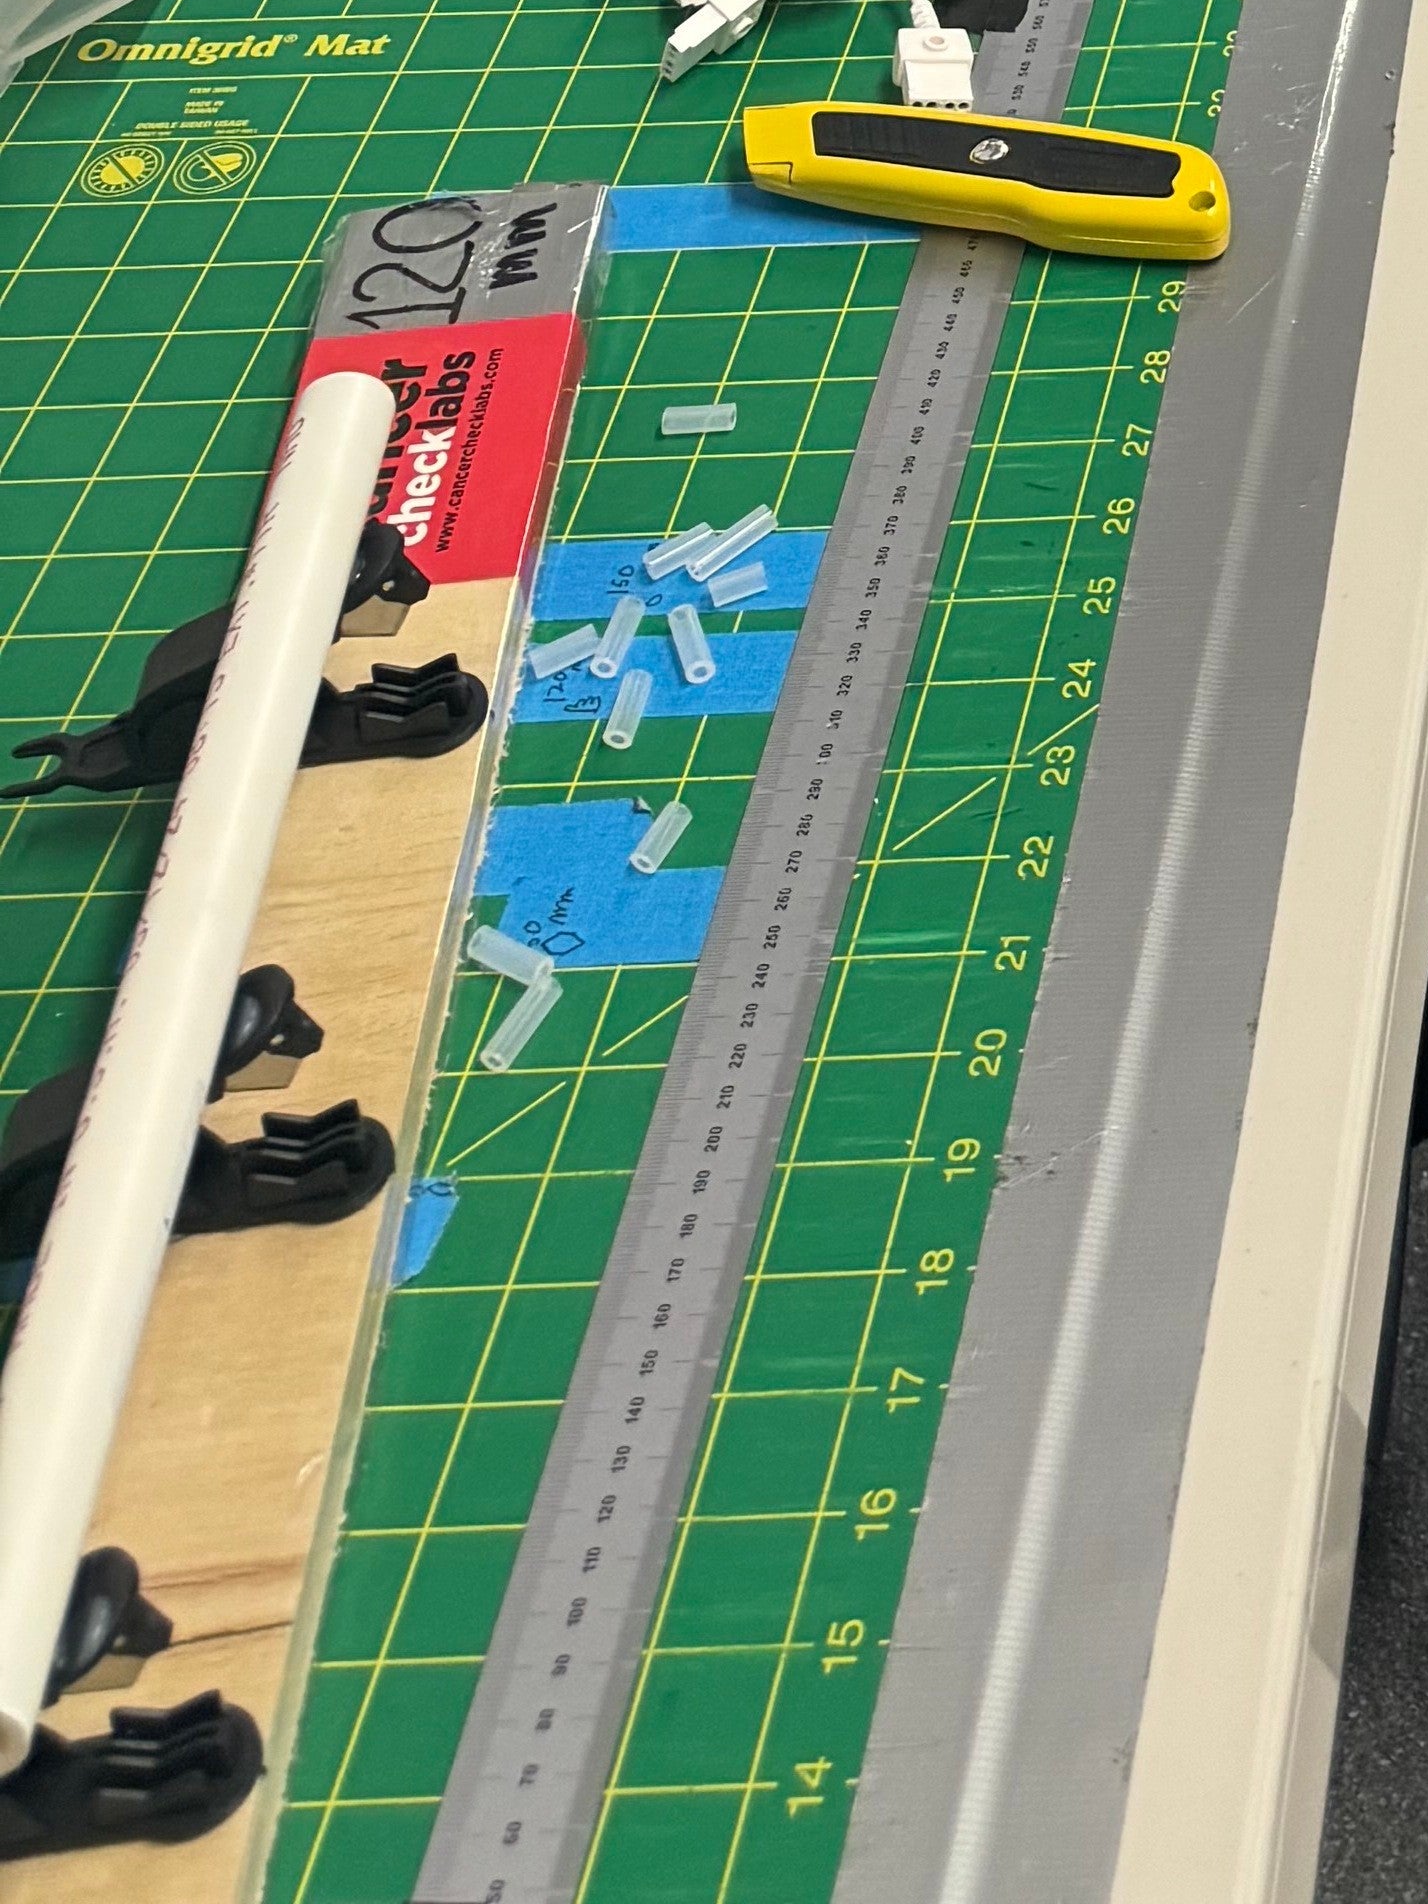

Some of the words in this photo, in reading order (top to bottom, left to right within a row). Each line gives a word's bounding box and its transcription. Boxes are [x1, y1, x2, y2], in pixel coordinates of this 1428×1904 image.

[304, 34, 391, 57] Mat
[489, 202, 558, 290] mm
[347, 196, 483, 330] 120
[1157, 280, 1187, 314] 29
[927, 369, 941, 388] 420
[1140, 349, 1171, 384] 28
[435, 347, 504, 553] www.cancerchecklabs.com
[1121, 423, 1154, 457] 27
[883, 515, 899, 536] 370
[1102, 497, 1135, 535] 26
[1083, 576, 1116, 614] 25
[856, 609, 872, 632] 340
[846, 642, 862, 664] 330
[837, 674, 853, 697] 320
[1061, 658, 1097, 699] 24
[1040, 745, 1076, 786] 23
[806, 778, 824, 801] 290
[796, 813, 814, 837] 280
[785, 850, 803, 874] 270
[1017, 835, 1055, 880] 22
[774, 887, 793, 912] 260
[763, 924, 781, 950] 250
[994, 935, 1031, 972] 21
[752, 962, 770, 989] 240
[740, 1003, 759, 1029] 230
[728, 1043, 747, 1070] 220
[968, 1028, 1008, 1077] 20
[716, 1085, 735, 1110] 210
[704, 1126, 723, 1153] 200
[943, 1137, 981, 1182] 19
[692, 1169, 711, 1196] 190
[679, 1213, 698, 1240] 180
[666, 1257, 685, 1284] 170
[915, 1248, 955, 1296] 18
[652, 1303, 672, 1330] 160
[639, 1349, 659, 1377] 150
[886, 1367, 925, 1413] 17
[625, 1396, 646, 1425] 140
[610, 1445, 631, 1474] 130
[597, 1494, 617, 1524] 120
[854, 1488, 897, 1541] 16
[582, 1546, 602, 1574] 110
[566, 1597, 588, 1627] 100
[821, 1618, 865, 1675] 15
[550, 1653, 571, 1678] 90
[534, 1708, 556, 1733] 80
[519, 1763, 539, 1788] 70
[787, 1756, 833, 1818] 14
[502, 1821, 523, 1846] 60
